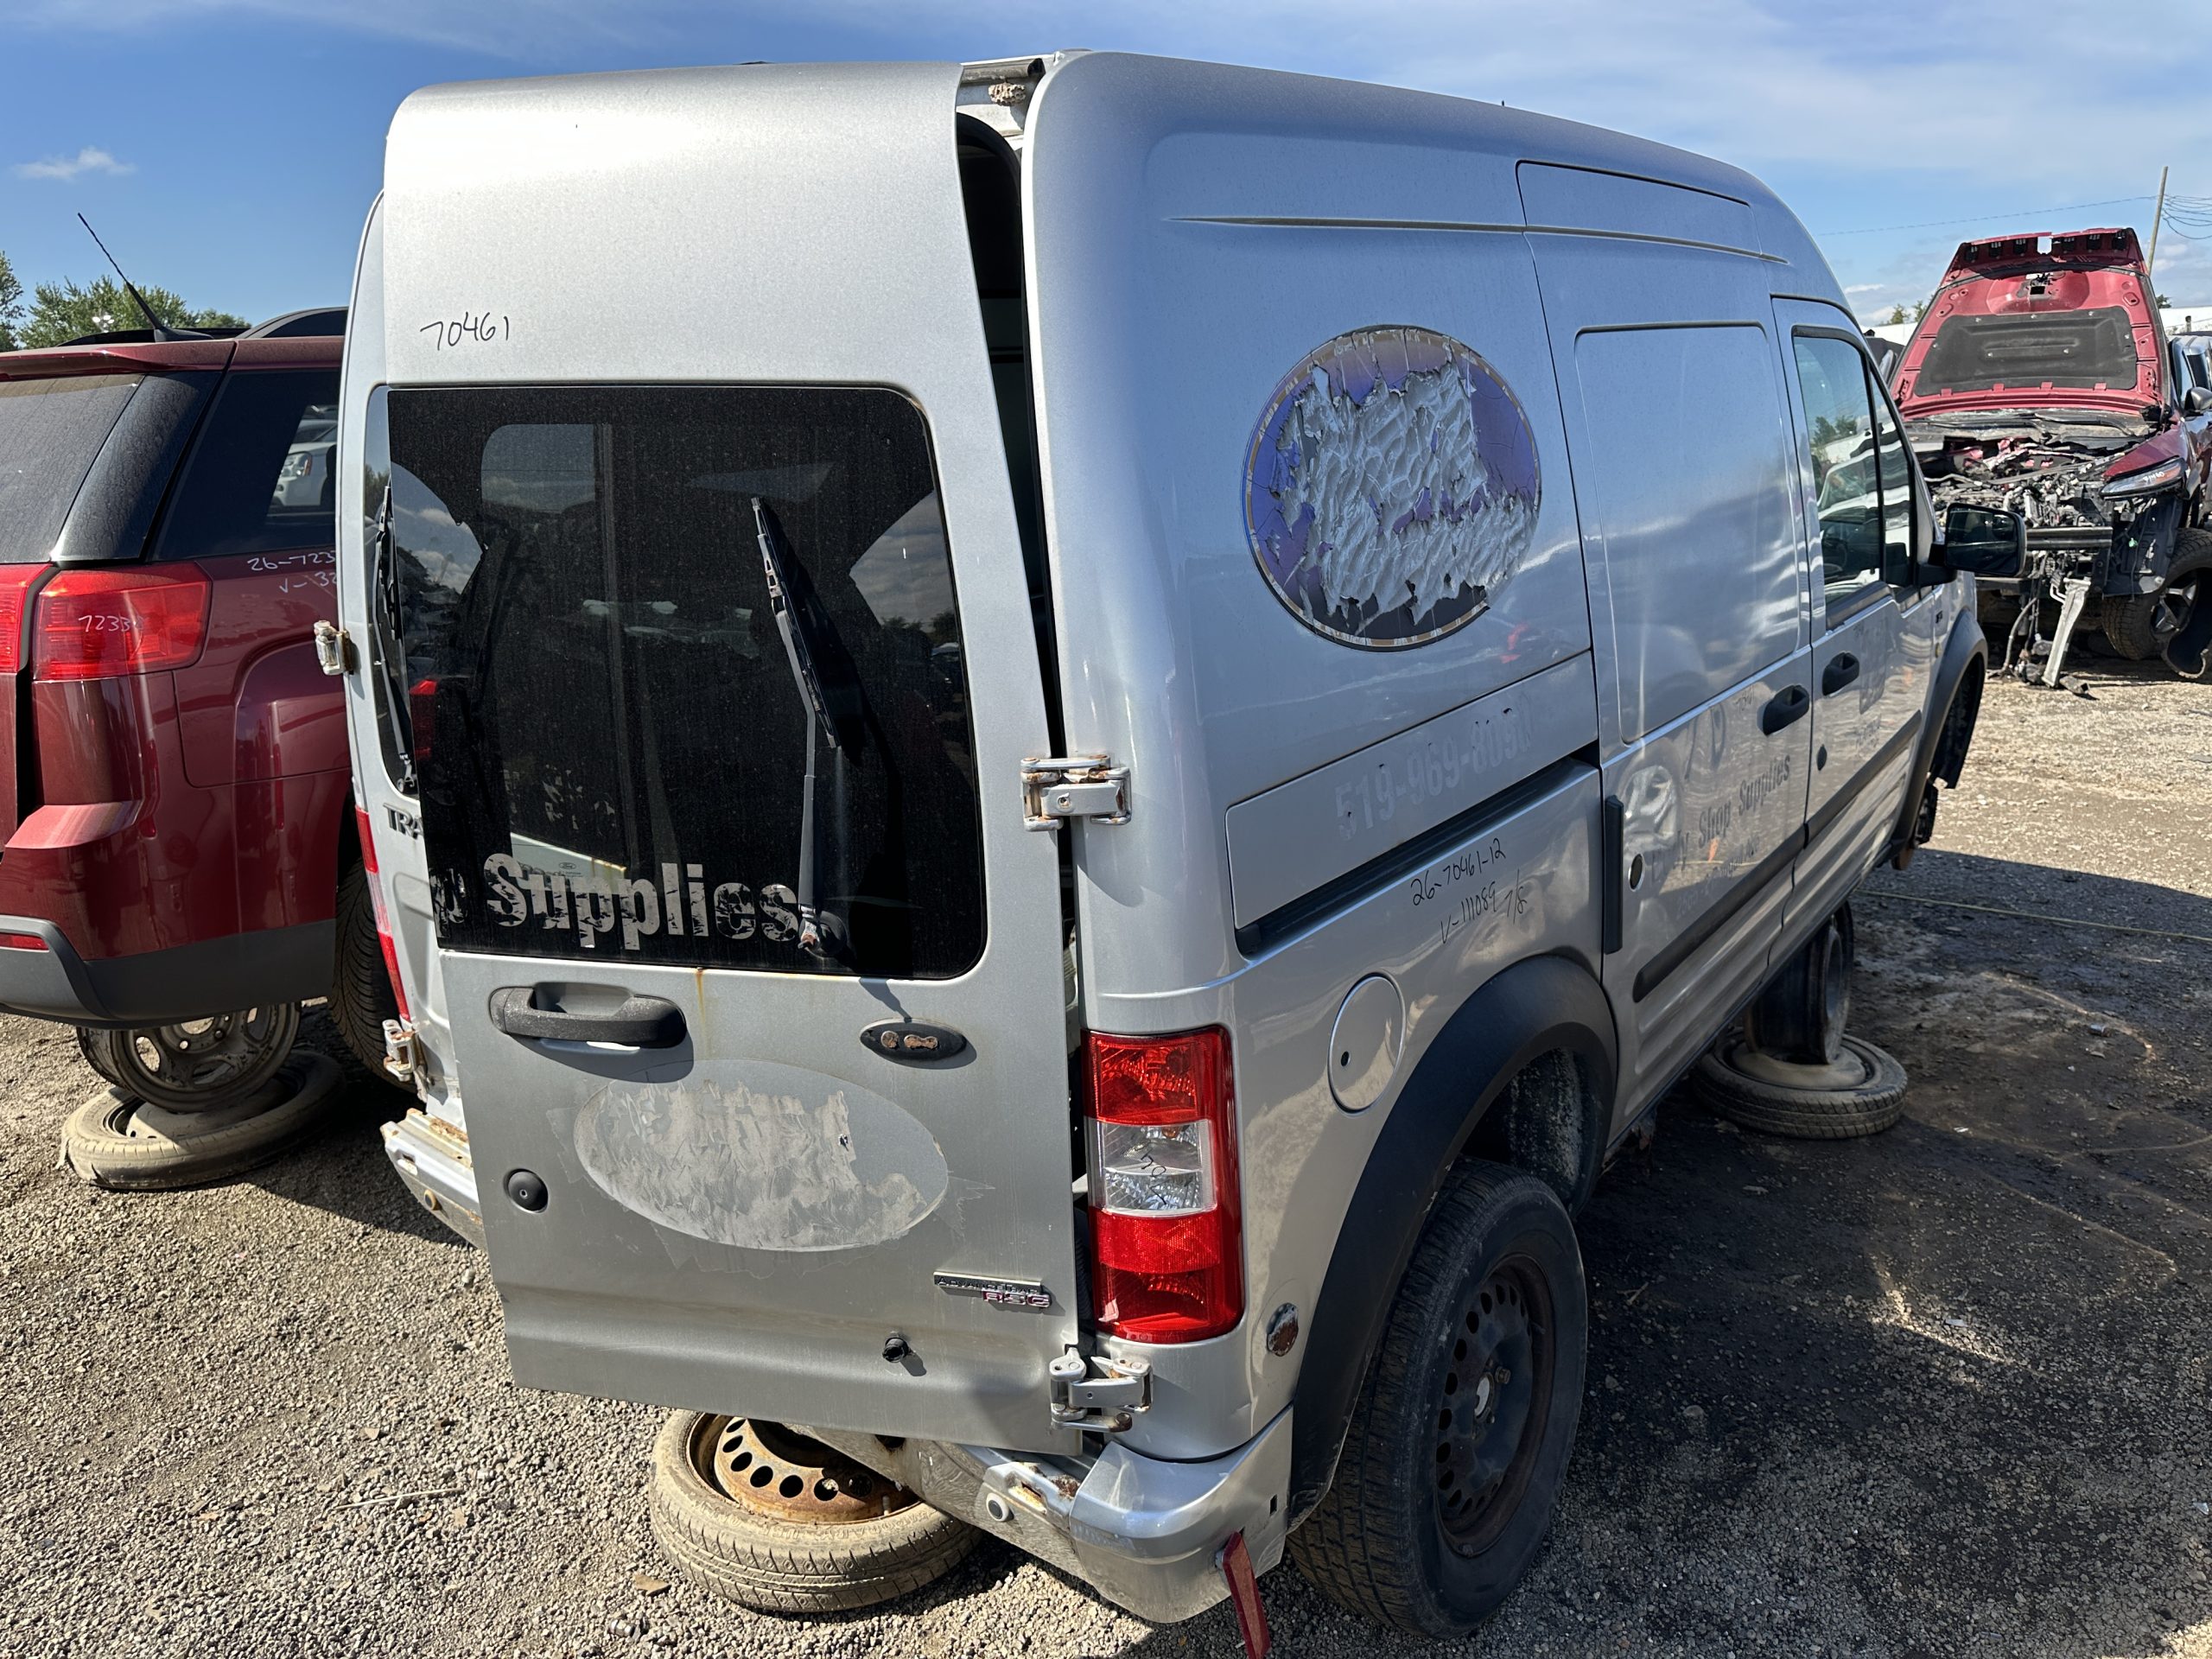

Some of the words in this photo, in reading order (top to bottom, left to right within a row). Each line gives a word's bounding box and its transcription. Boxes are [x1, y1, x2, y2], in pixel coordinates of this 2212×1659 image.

[419, 311, 510, 352] 70461
[247, 550, 336, 570] 26-723
[1410, 837, 1507, 906] 26-70461-12
[482, 852, 799, 951] Supplies
